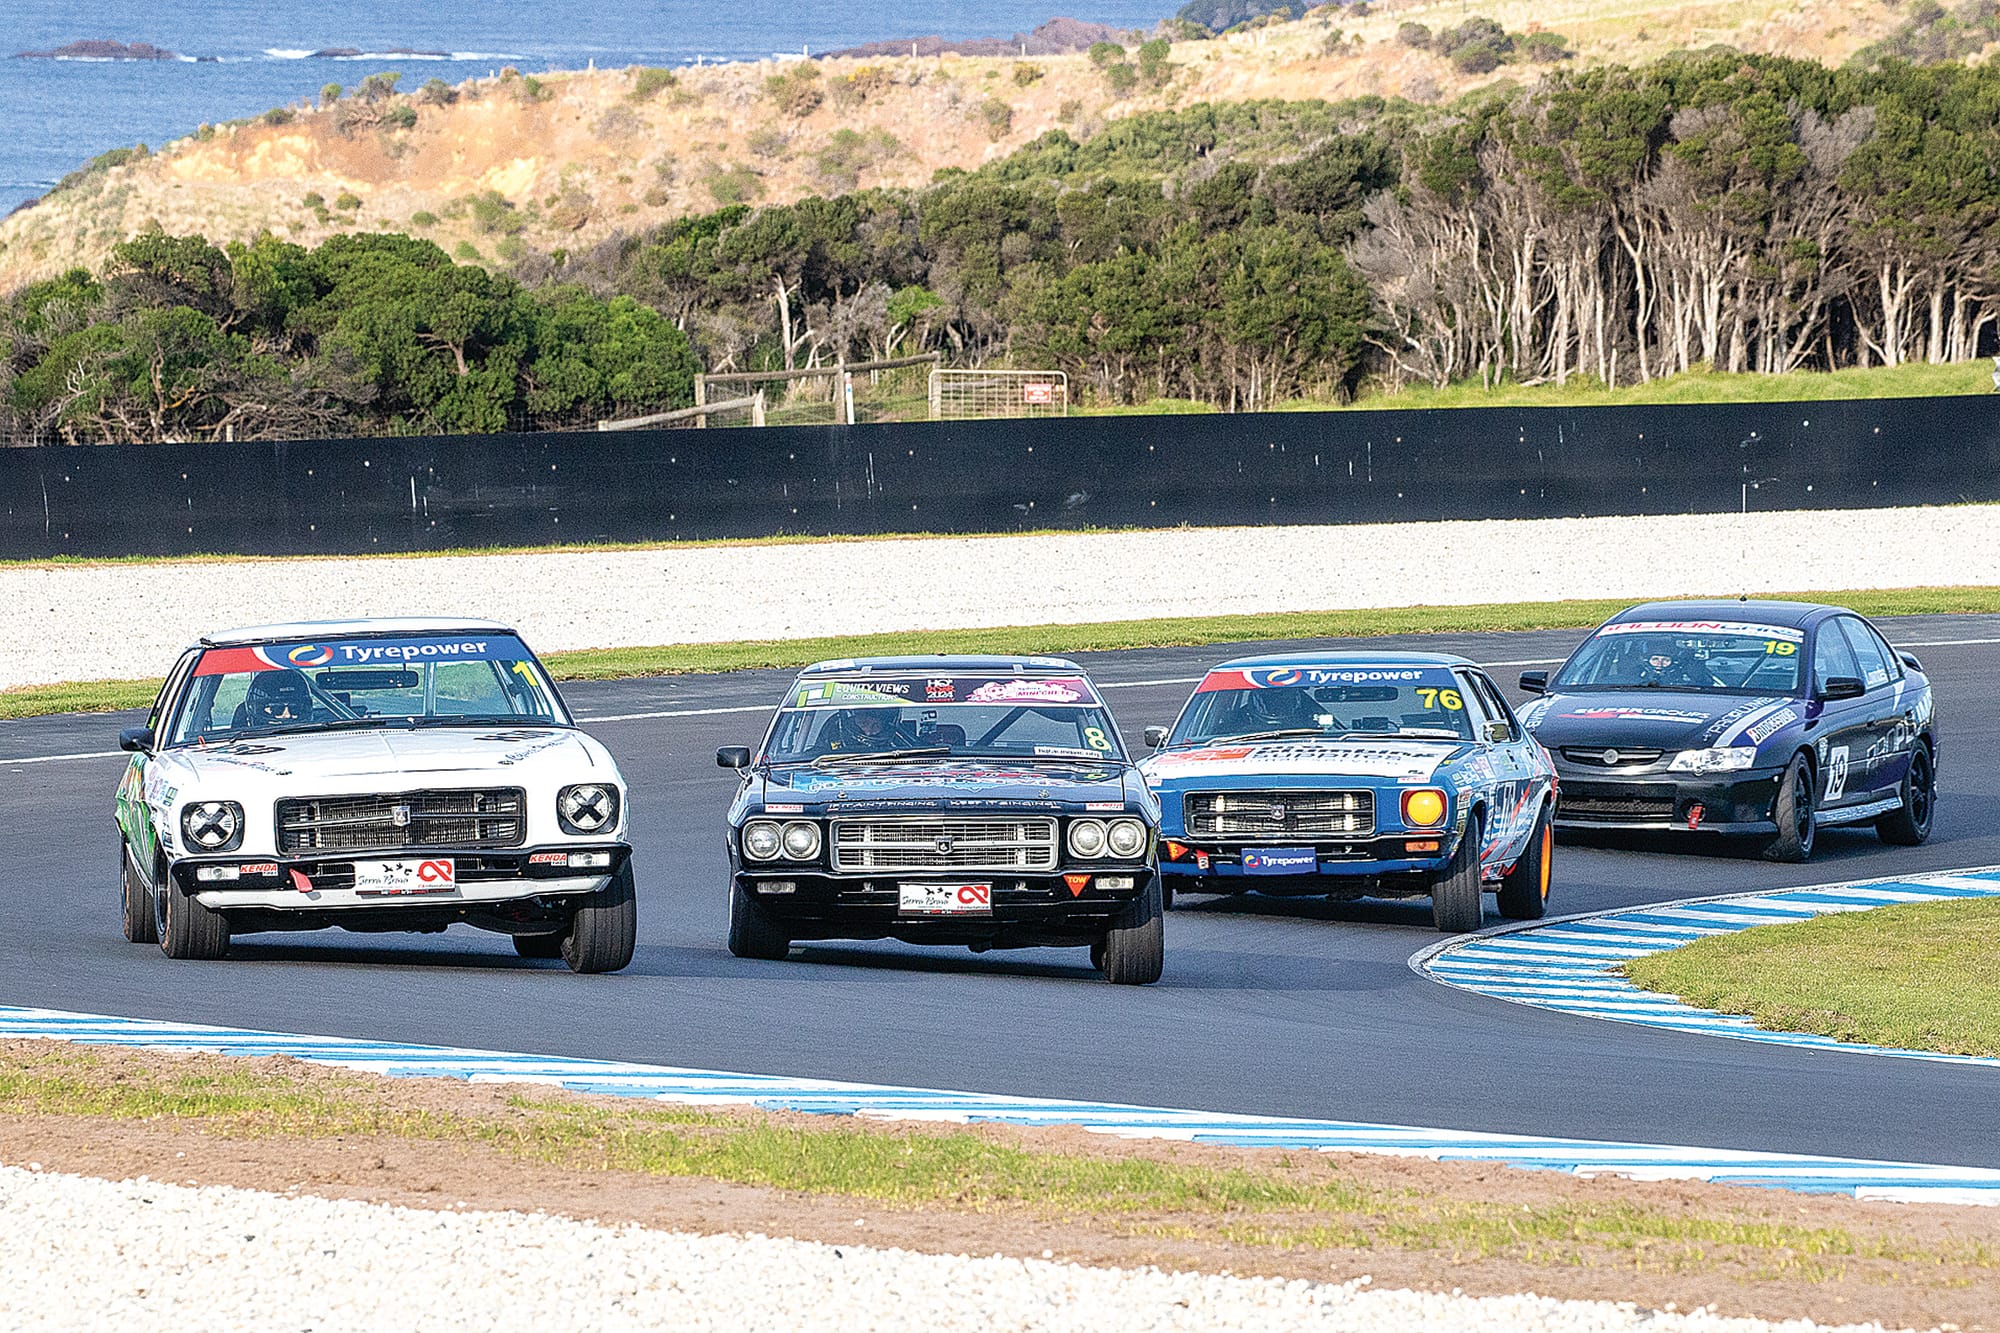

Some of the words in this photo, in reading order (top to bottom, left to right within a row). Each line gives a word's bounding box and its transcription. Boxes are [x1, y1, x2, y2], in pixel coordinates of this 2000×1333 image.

[339, 641, 487, 662] Tyrepower
[1763, 640, 1795, 656] 19
[511, 661, 539, 687] 1
[1306, 670, 1423, 684] Tyrepower
[835, 683, 875, 693] EQUITY
[875, 683, 910, 693] VIEWS
[1415, 688, 1463, 711] 76
[1573, 708, 1711, 719] SUPERGROUPS
[1083, 726, 1113, 753] 8
[1828, 753, 1846, 795] 19
[530, 854, 567, 863] KENDA
[1260, 855, 1315, 867] Tyrepower
[240, 863, 277, 873] KENDA
[1067, 876, 1087, 884] TOW
